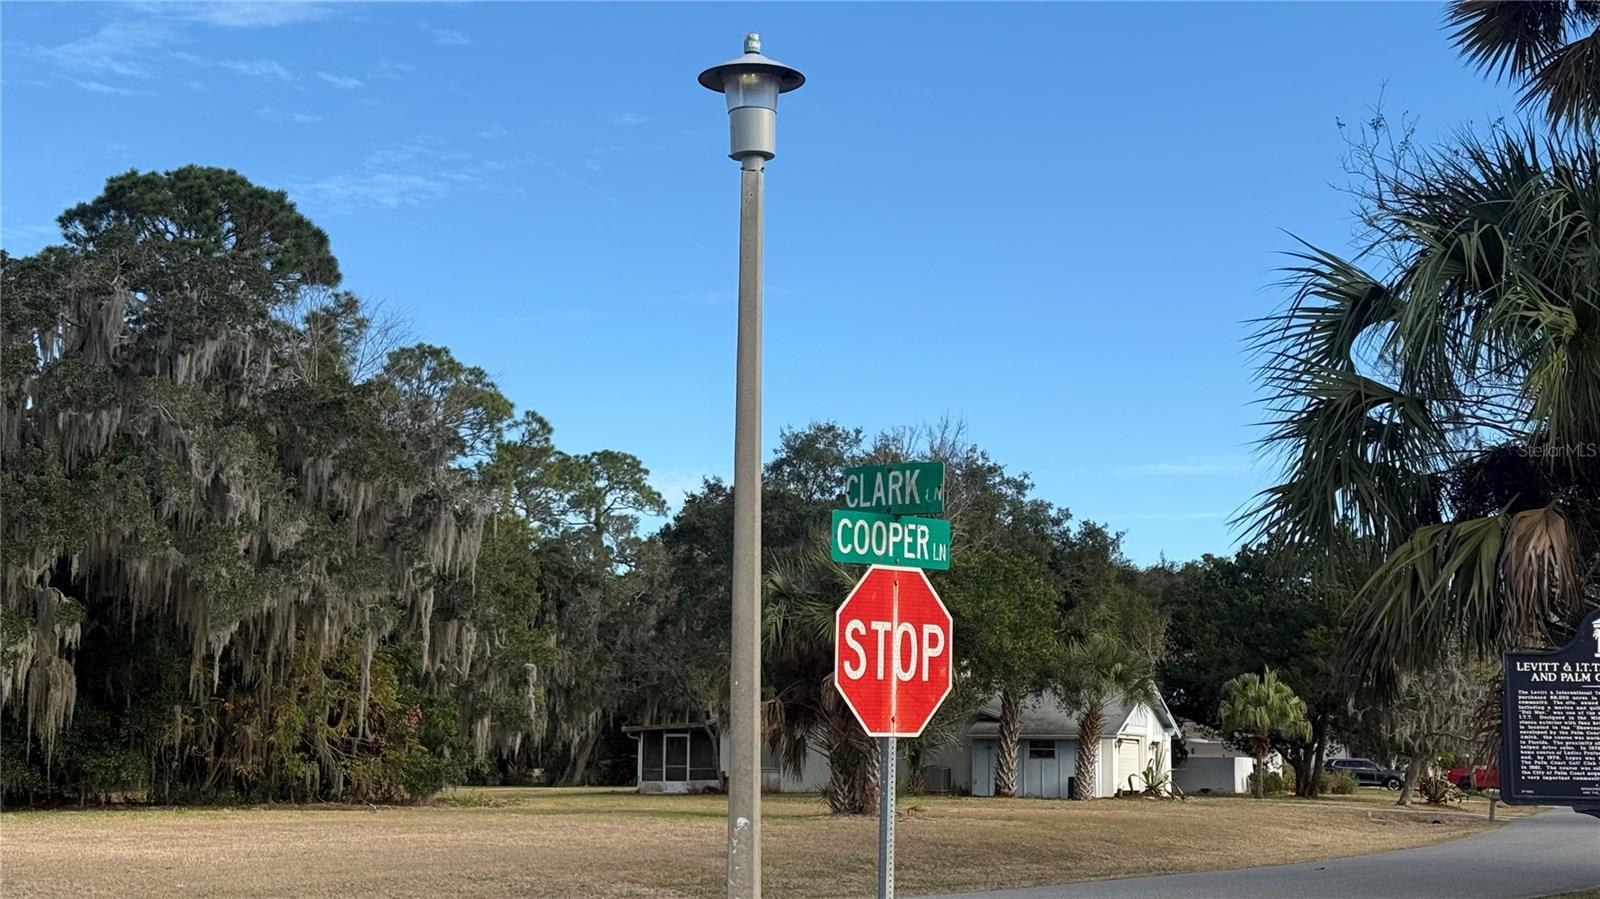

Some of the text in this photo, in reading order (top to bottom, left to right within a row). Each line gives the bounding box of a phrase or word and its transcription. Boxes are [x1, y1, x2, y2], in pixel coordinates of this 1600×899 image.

[846, 469, 942, 508] CLARK LN
[837, 518, 947, 561] COOPER LN
[843, 619, 945, 682] STOP
[1516, 662, 1560, 672] LEVITT
[1563, 662, 1572, 672] &
[1531, 672, 1557, 682] AND
[1560, 672, 1591, 682] PALM
